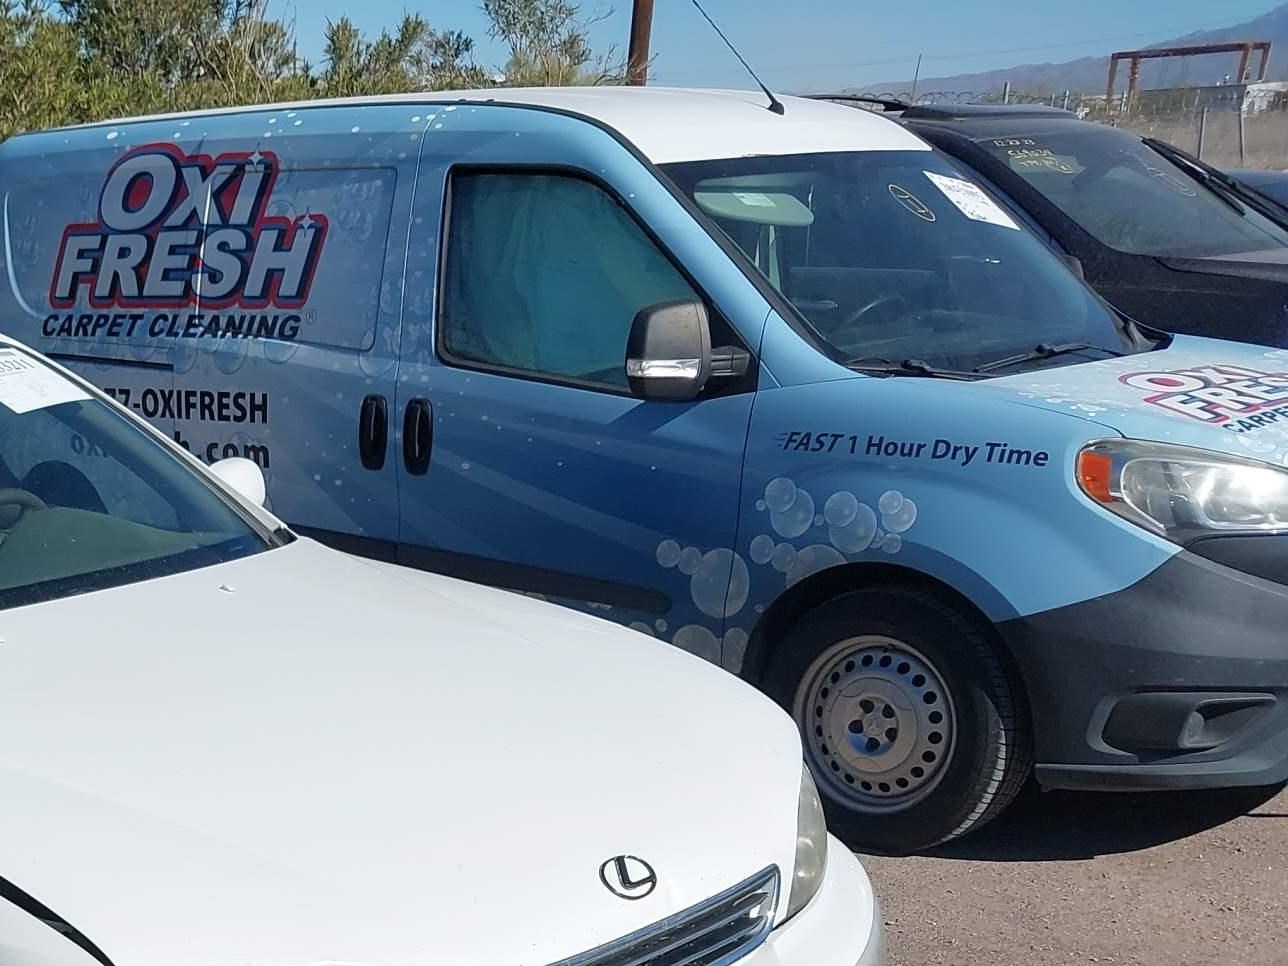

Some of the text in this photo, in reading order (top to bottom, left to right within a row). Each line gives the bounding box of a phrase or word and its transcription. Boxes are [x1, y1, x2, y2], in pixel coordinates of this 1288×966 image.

[99, 150, 270, 231] OXI
[53, 223, 321, 301] FRESH
[42, 313, 301, 340] CARPET CLEANING
[782, 431, 1050, 467] FAST 1 Hour Dry Time
